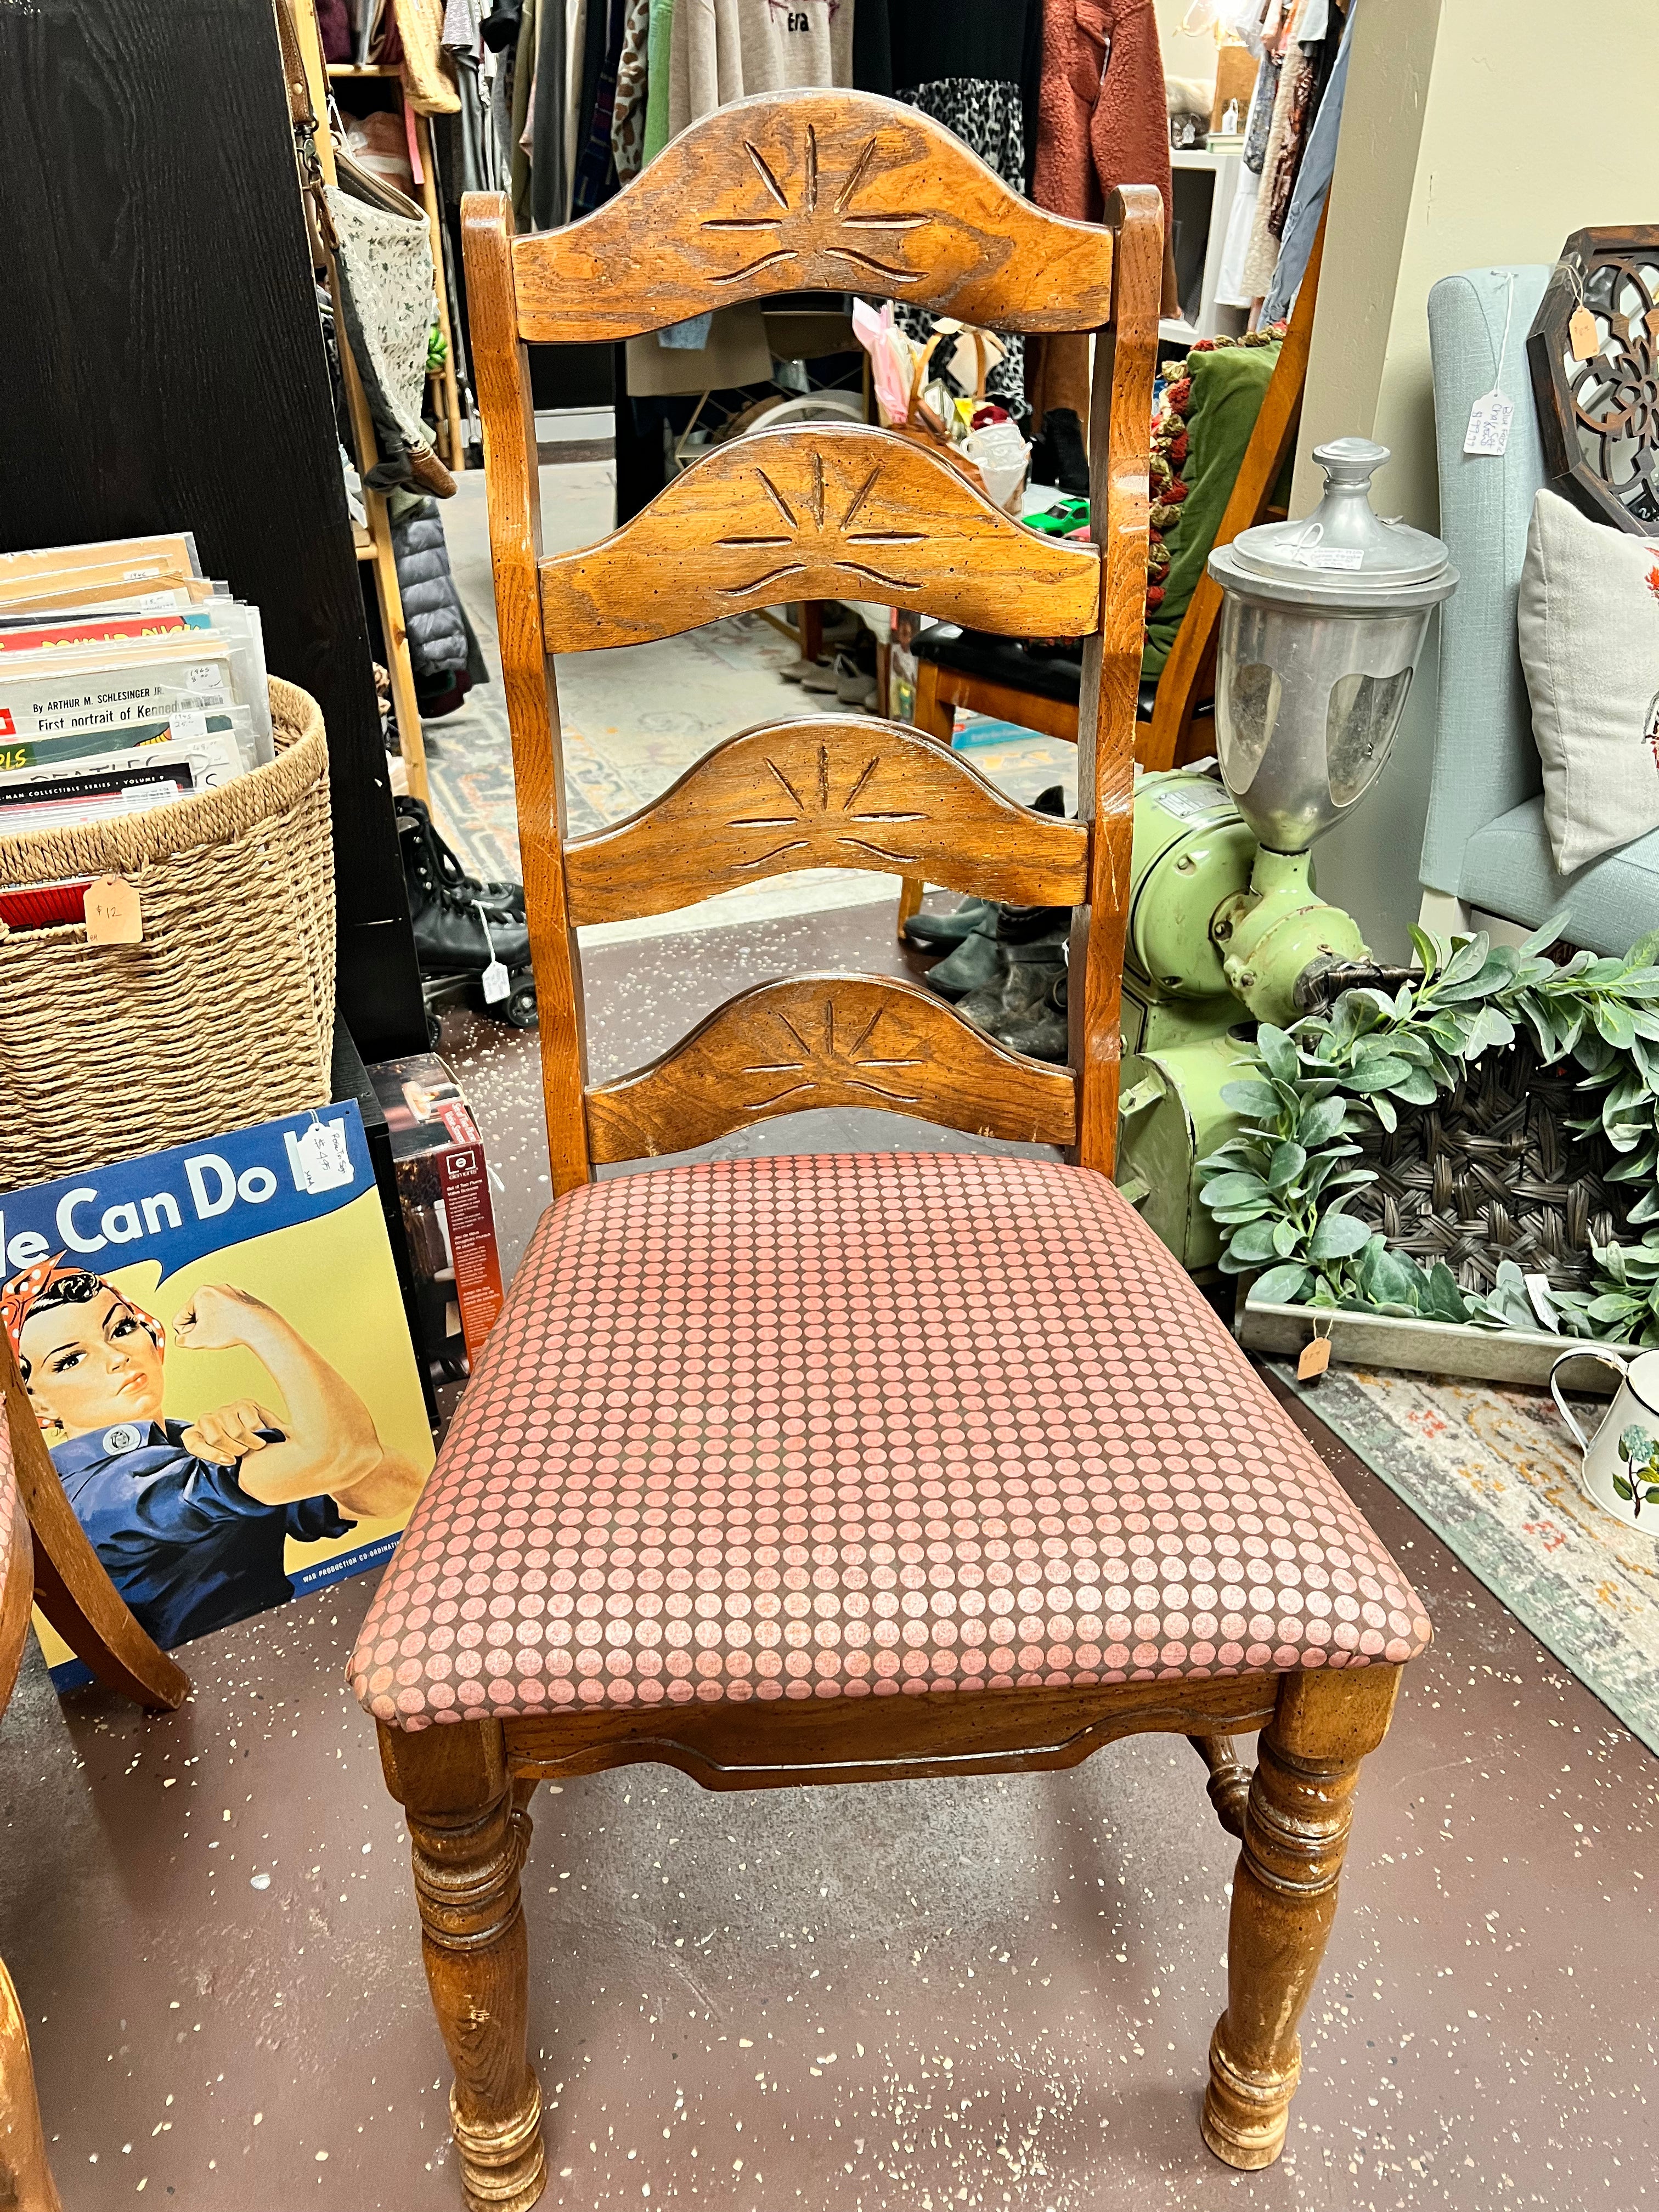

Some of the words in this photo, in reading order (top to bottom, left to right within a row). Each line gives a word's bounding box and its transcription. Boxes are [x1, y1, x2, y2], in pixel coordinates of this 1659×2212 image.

[788, 12, 809, 32] Era
[33, 704, 43, 714] By
[48, 698, 80, 711] ARTHUR
[84, 697, 93, 706] M.
[97, 688, 150, 704] SCHLESINGER
[38, 718, 64, 731] First
[120, 707, 131, 720] of
[137, 700, 179, 718] Kenned
[29, 786, 80, 797] COLLECTIBLE
[84, 782, 111, 790] SERIES
[123, 776, 155, 785] VOLUME
[0, 1210, 50, 1278] e
[55, 1187, 183, 1254] Can
[184, 1153, 278, 1220] Do
[302, 1572, 317, 1583] WAR
[318, 1556, 357, 1577] PRODUCTION
[359, 1539, 400, 1562] CO-ORDINATIN
